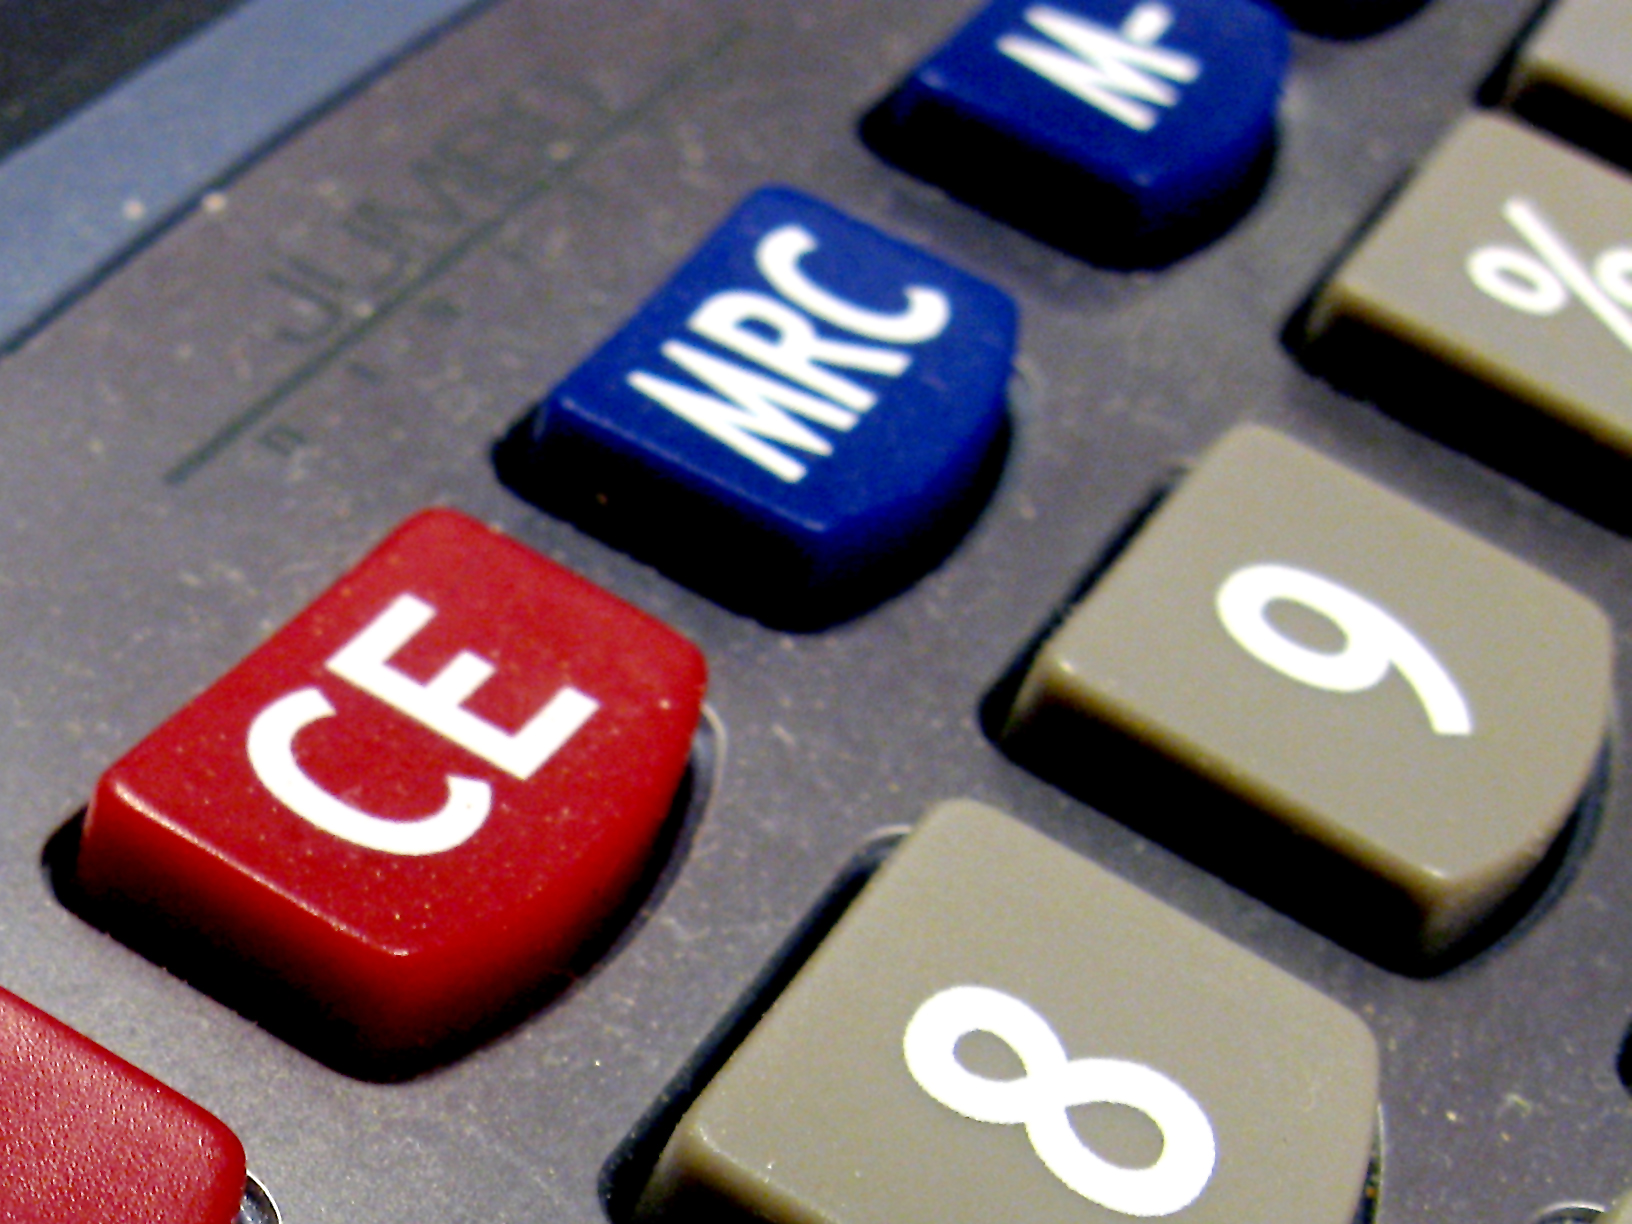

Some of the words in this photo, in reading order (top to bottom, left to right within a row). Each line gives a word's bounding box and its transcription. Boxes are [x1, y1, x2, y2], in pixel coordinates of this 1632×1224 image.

[996, 2, 1203, 131] M-
[628, 225, 950, 483] MRC
[1466, 196, 1632, 352] %
[245, 593, 600, 857] CE
[1215, 562, 1475, 738] 9
[902, 983, 1217, 1218] 8
